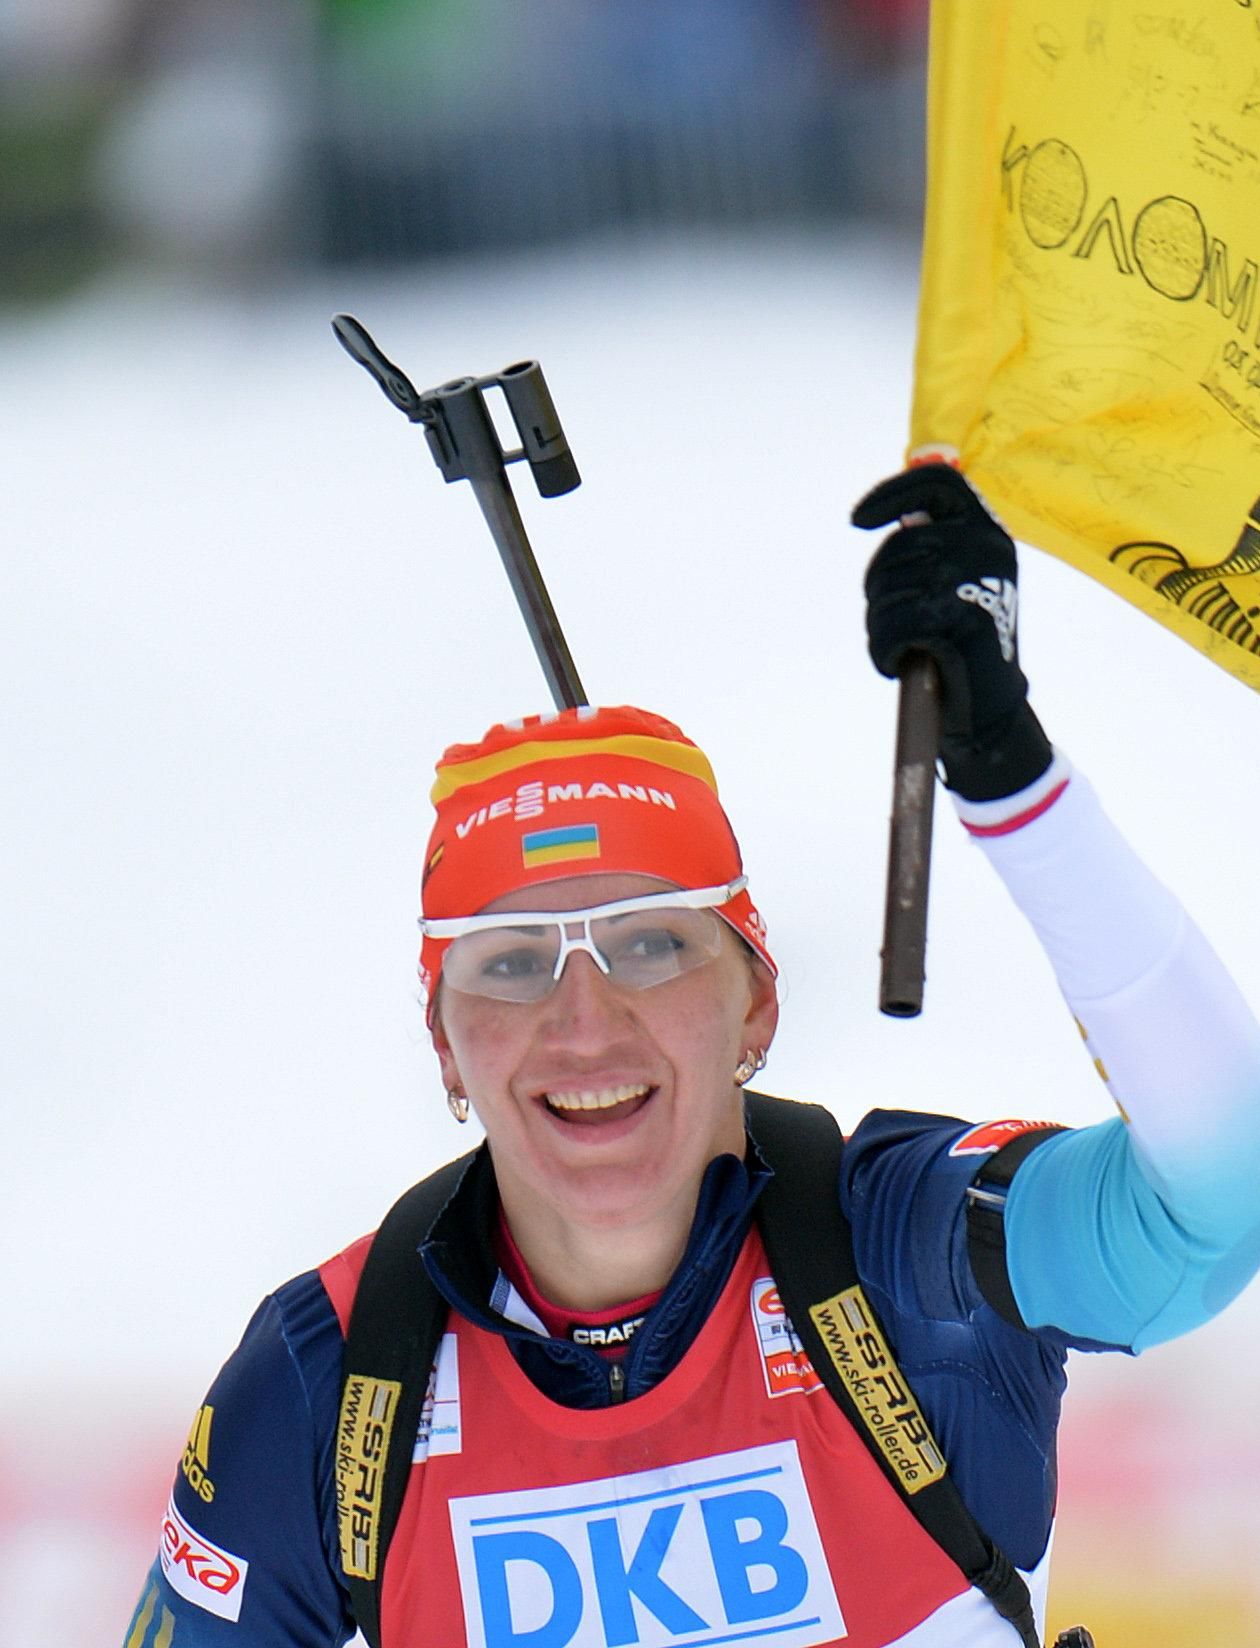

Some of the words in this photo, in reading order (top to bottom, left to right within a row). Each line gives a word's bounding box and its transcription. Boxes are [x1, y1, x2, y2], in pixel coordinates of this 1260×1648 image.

[455, 780, 677, 839] VIESSMANN
[816, 1307, 918, 1482] www.ski-roller.de
[472, 1489, 810, 1648] DKB
